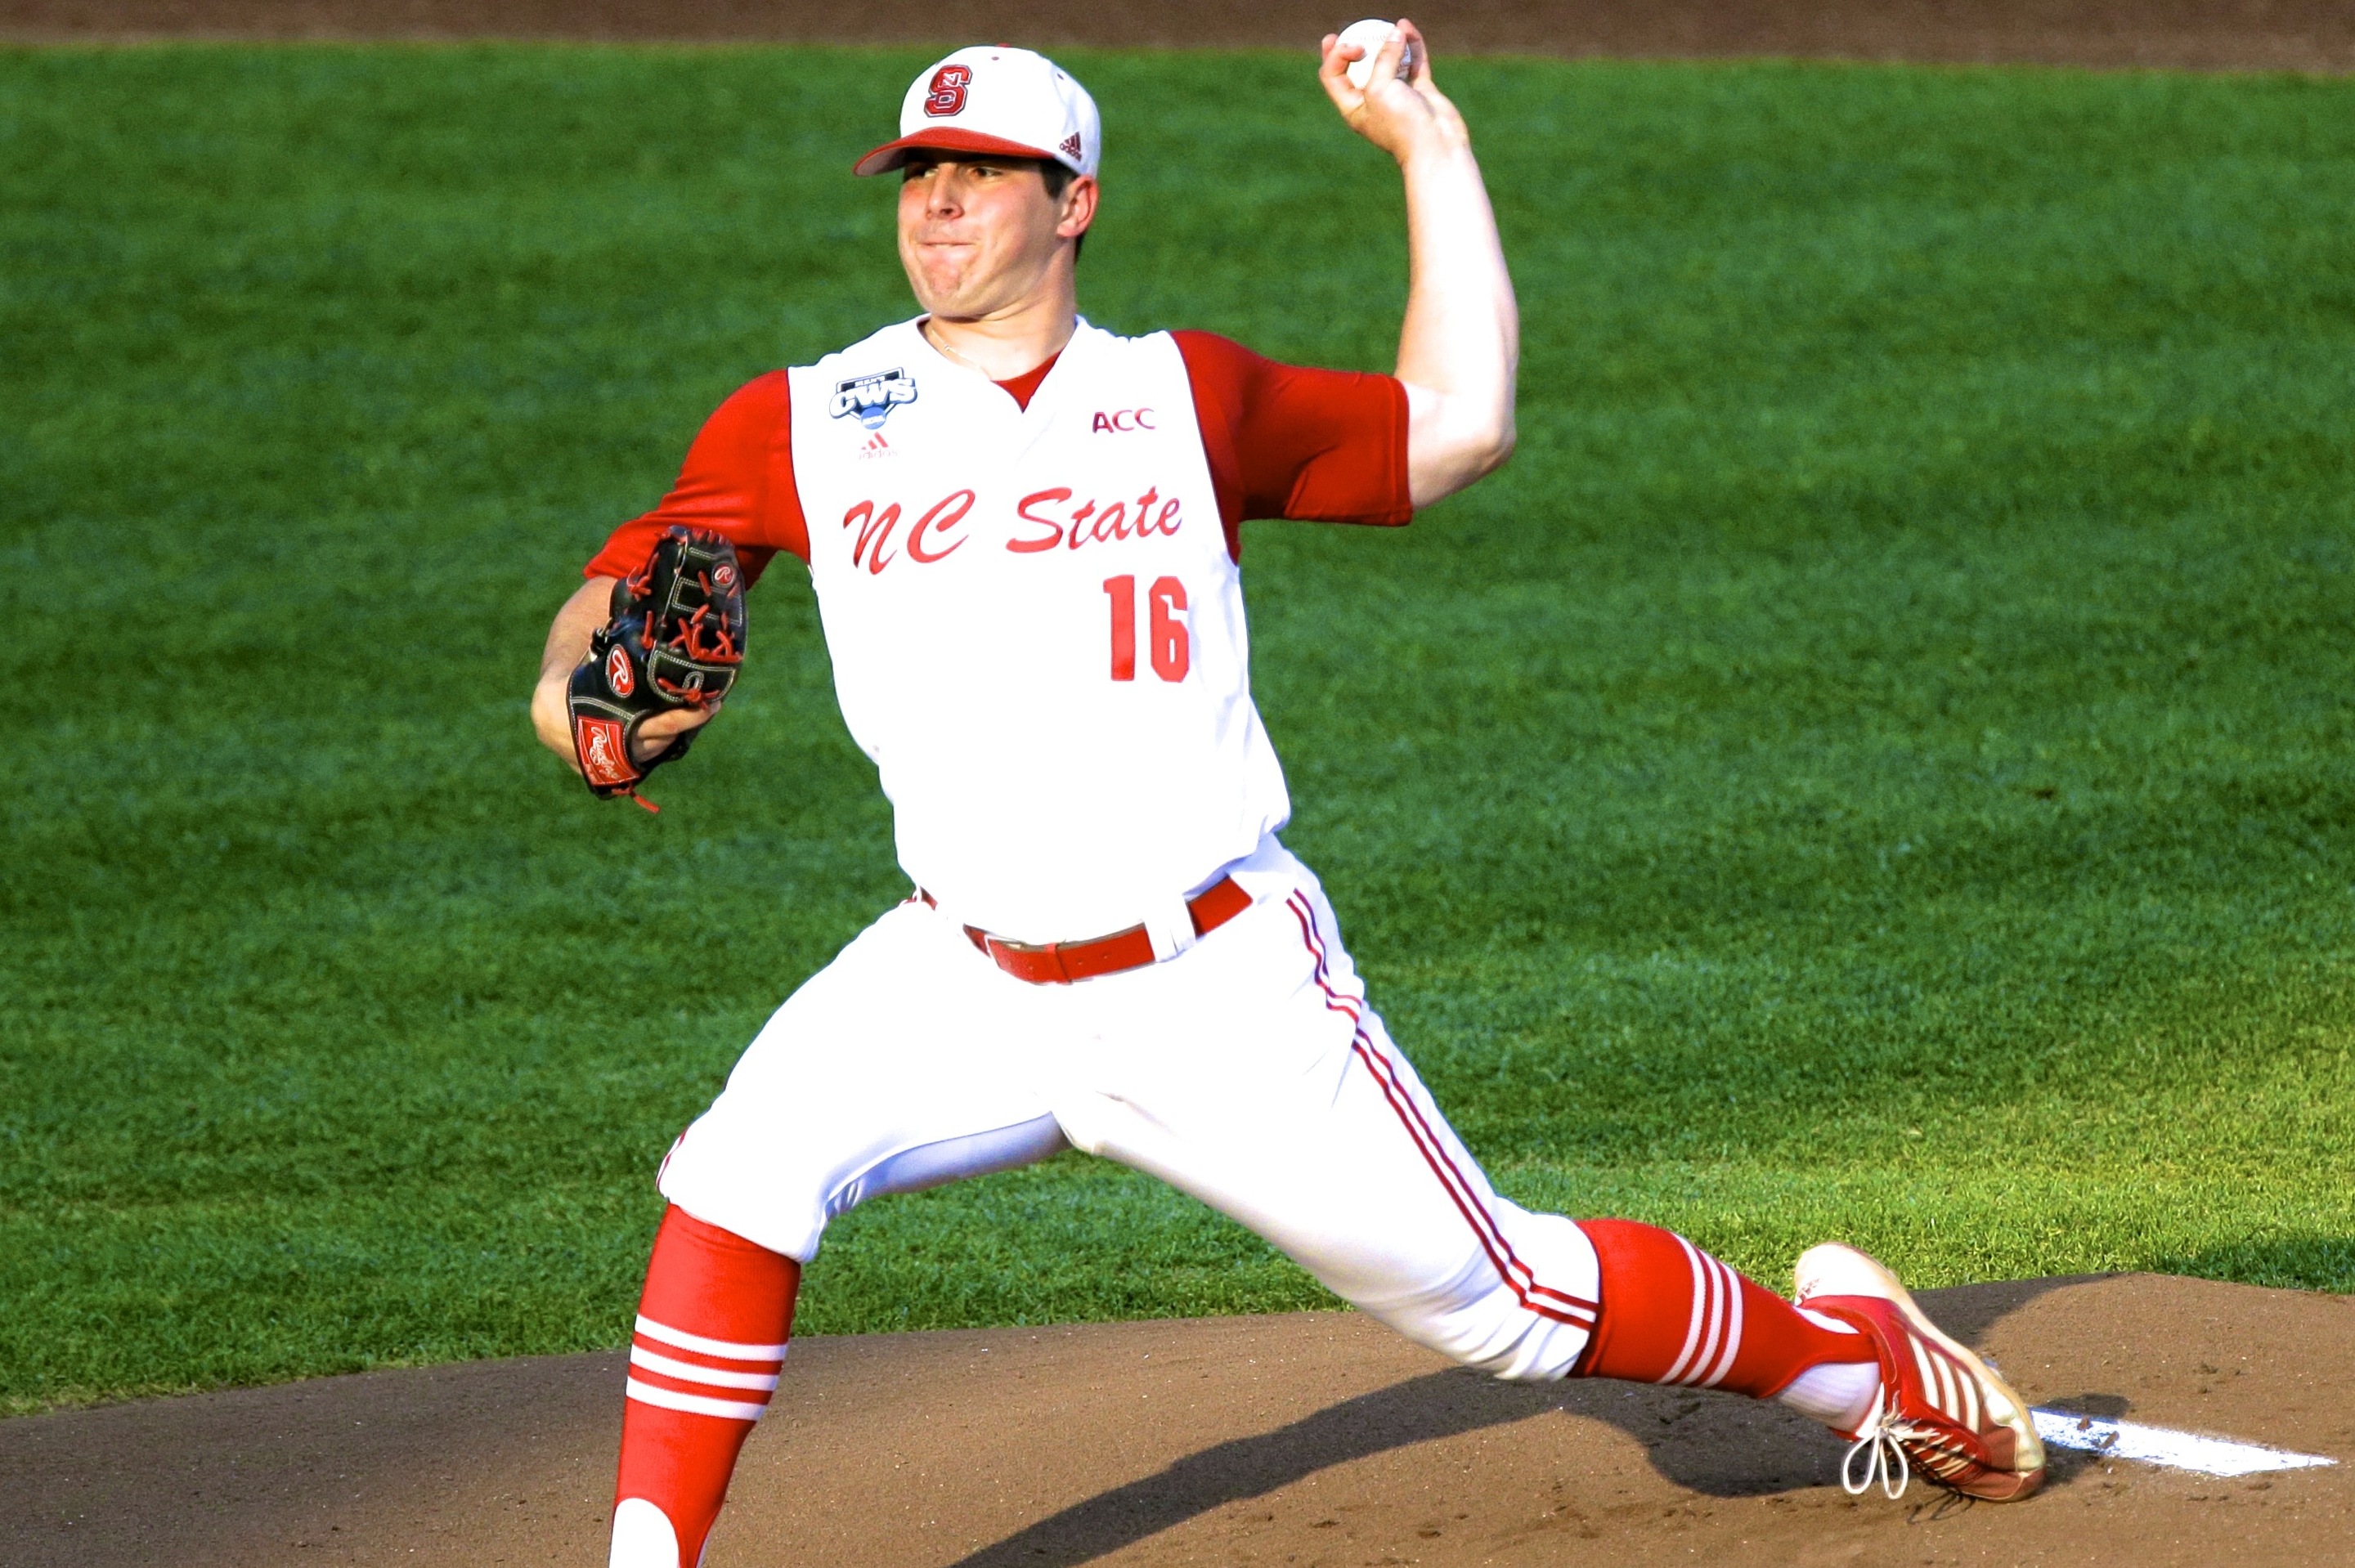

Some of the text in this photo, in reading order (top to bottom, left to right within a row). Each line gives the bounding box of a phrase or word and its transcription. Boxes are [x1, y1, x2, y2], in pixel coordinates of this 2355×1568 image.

[829, 377, 917, 419] CWS
[1092, 407, 1156, 434] ACC
[843, 485, 1182, 576] NC State
[1102, 574, 1191, 683] 16
